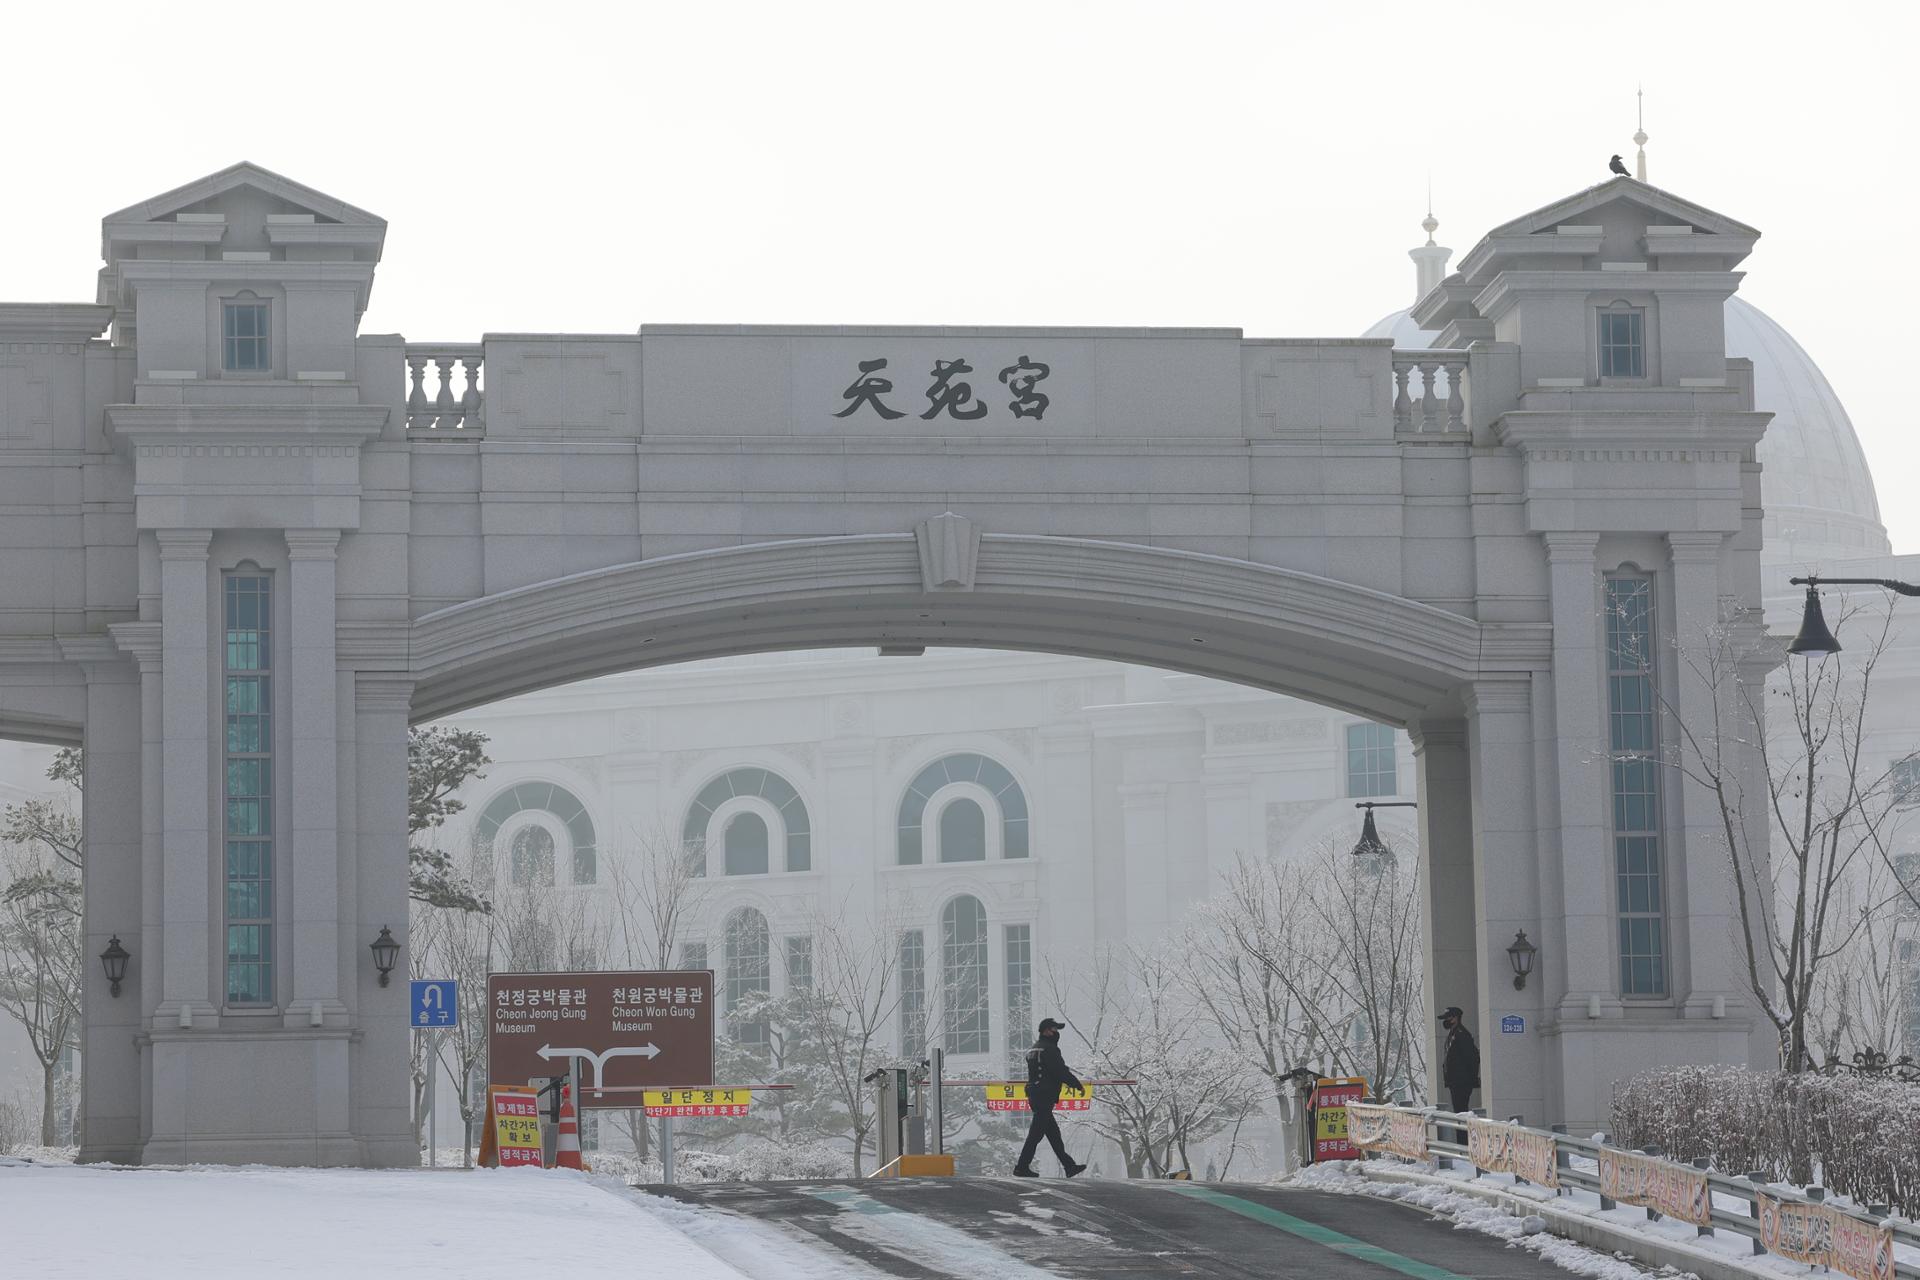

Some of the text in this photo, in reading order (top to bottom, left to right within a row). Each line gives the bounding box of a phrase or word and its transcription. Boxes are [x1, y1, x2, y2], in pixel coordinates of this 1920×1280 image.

[831, 355, 1050, 420] 天苑宮
[496, 989, 587, 1006] 천정궁박물관
[612, 987, 703, 1004] 천원궁박물관
[496, 1007, 587, 1021] Cheon Jeong Gung
[612, 1006, 695, 1019] Cheon Won Gung
[496, 1022, 536, 1034] Museum
[612, 1020, 652, 1032] Museum
[500, 1119, 538, 1131] 차간거리
[501, 1149, 540, 1161] 경적금지
